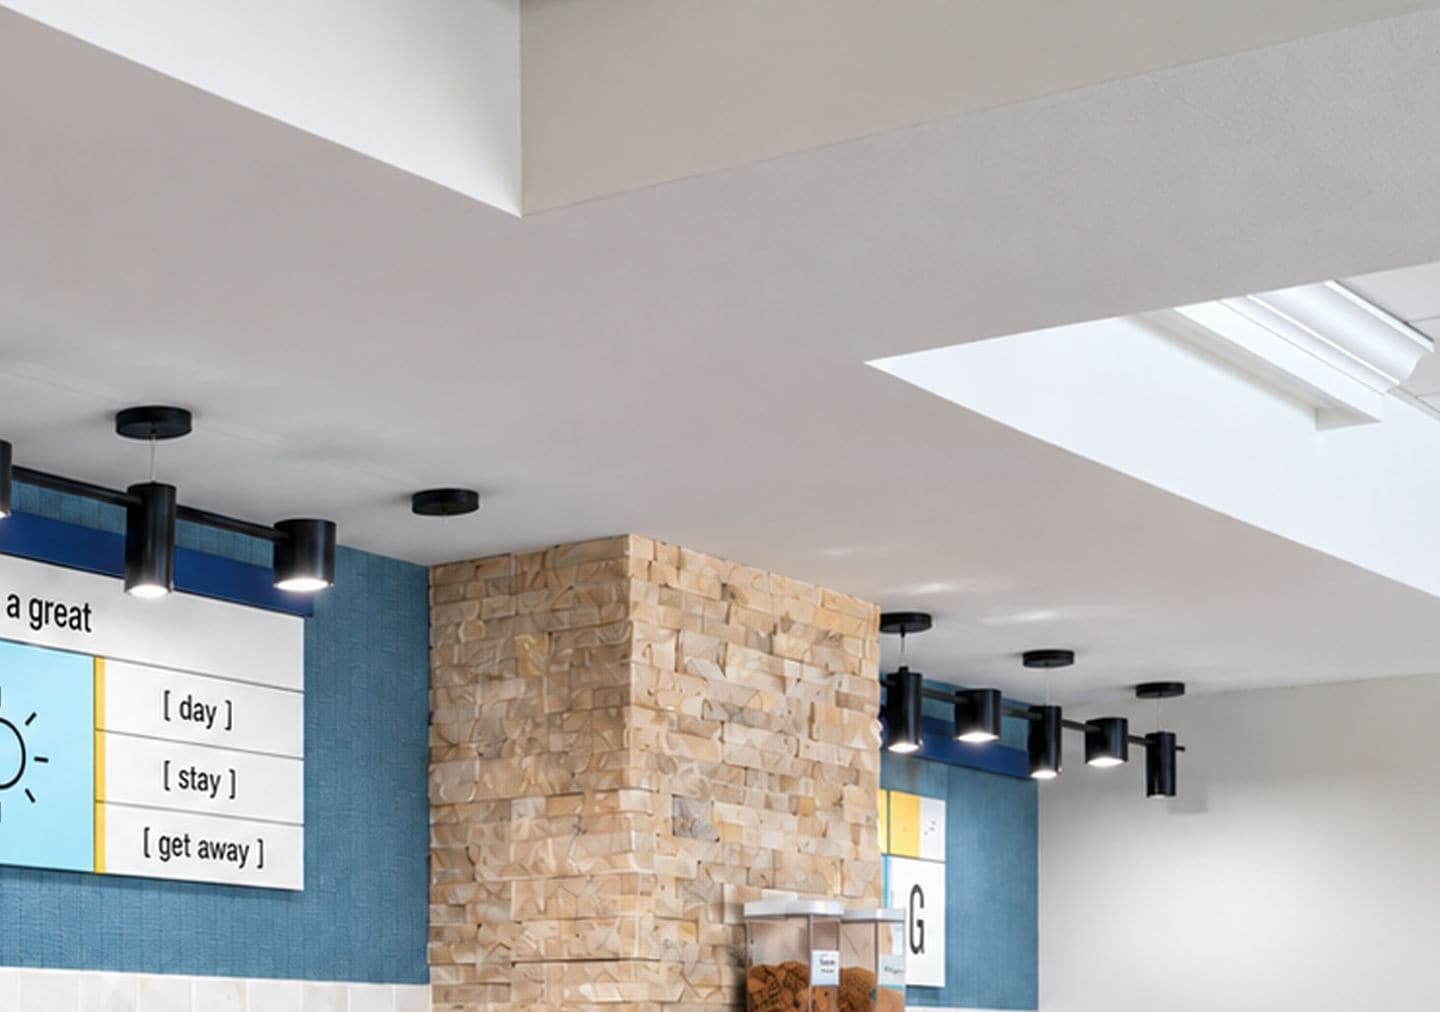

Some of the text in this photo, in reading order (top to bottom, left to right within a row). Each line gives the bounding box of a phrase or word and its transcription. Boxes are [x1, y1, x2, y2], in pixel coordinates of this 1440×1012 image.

[6, 593, 21, 619] a
[28, 597, 92, 633] great
[158, 833, 191, 862] get
[197, 839, 250, 869] away
[909, 883, 925, 955] G
